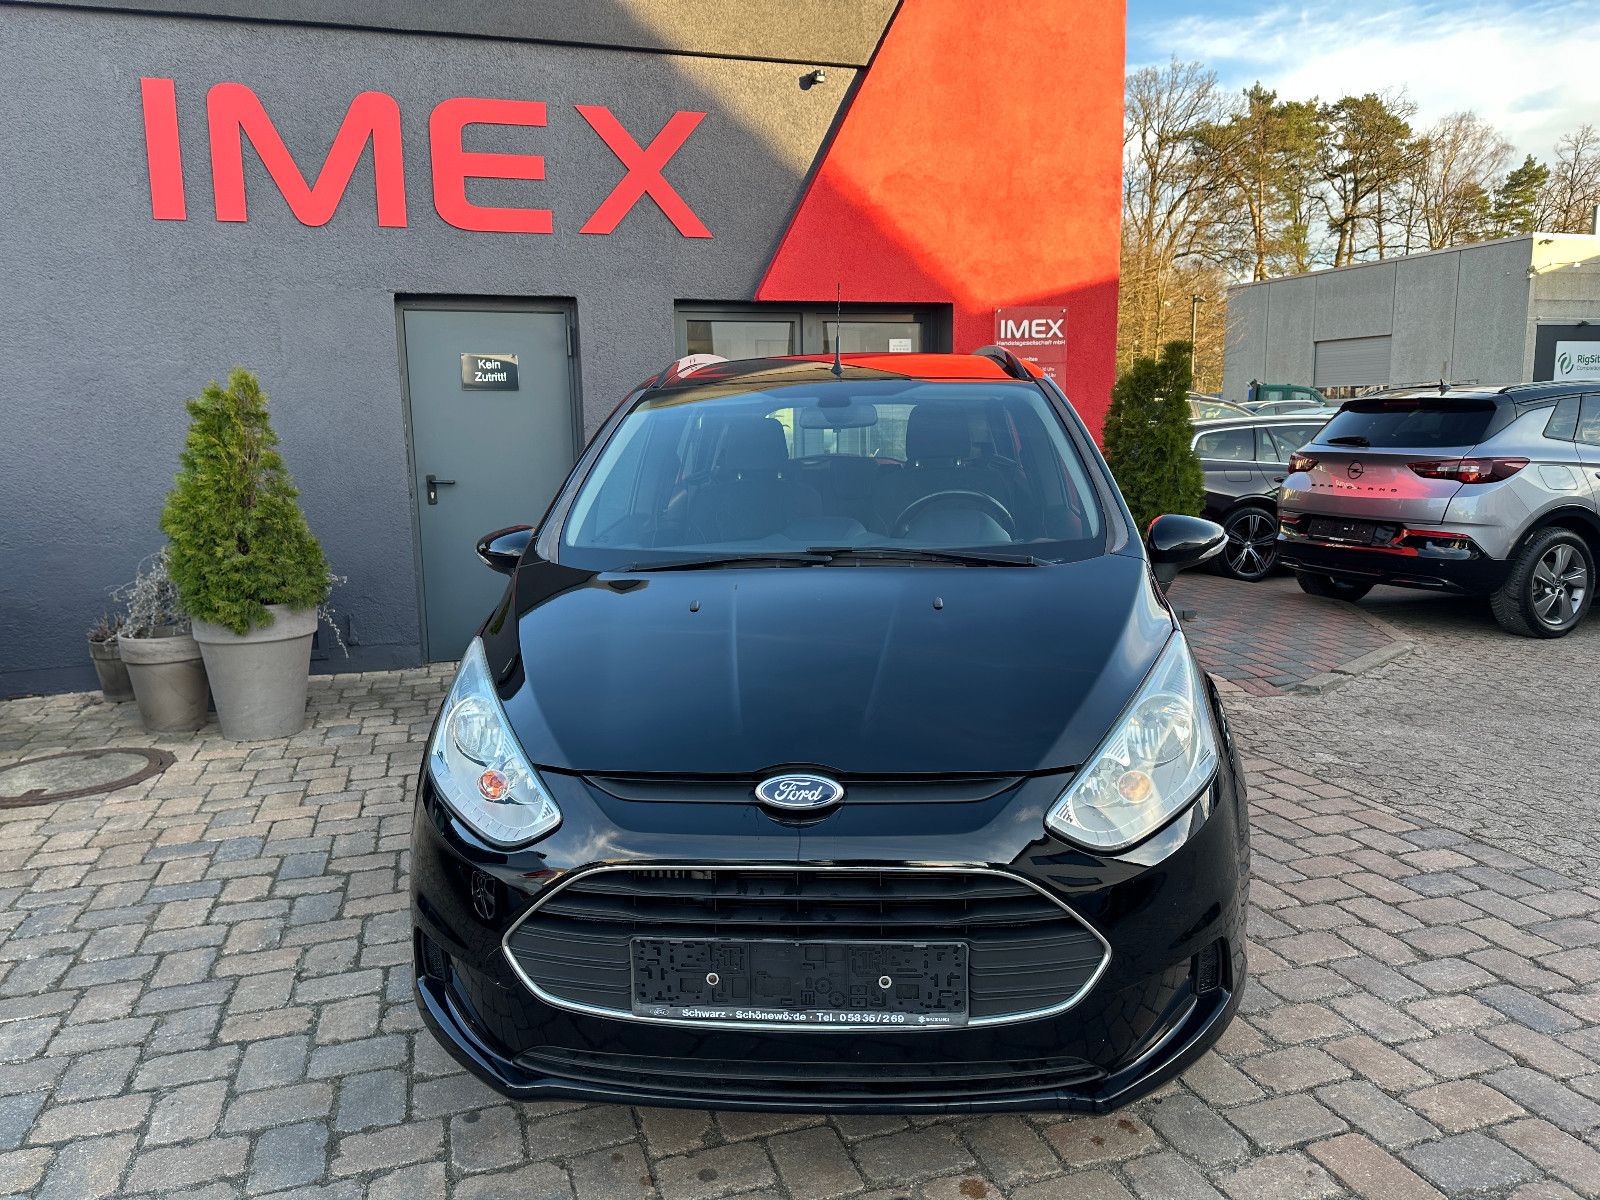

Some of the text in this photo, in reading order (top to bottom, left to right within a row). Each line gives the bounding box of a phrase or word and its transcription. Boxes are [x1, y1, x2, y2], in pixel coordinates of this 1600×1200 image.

[140, 77, 714, 239] IMEX
[1000, 319, 1064, 339] IMEX
[478, 359, 501, 370] Kein
[474, 371, 507, 382] Zutritt!
[774, 780, 823, 801] Ford
[682, 1008, 727, 1018] Schwarz
[816, 1012, 836, 1022] Tel.
